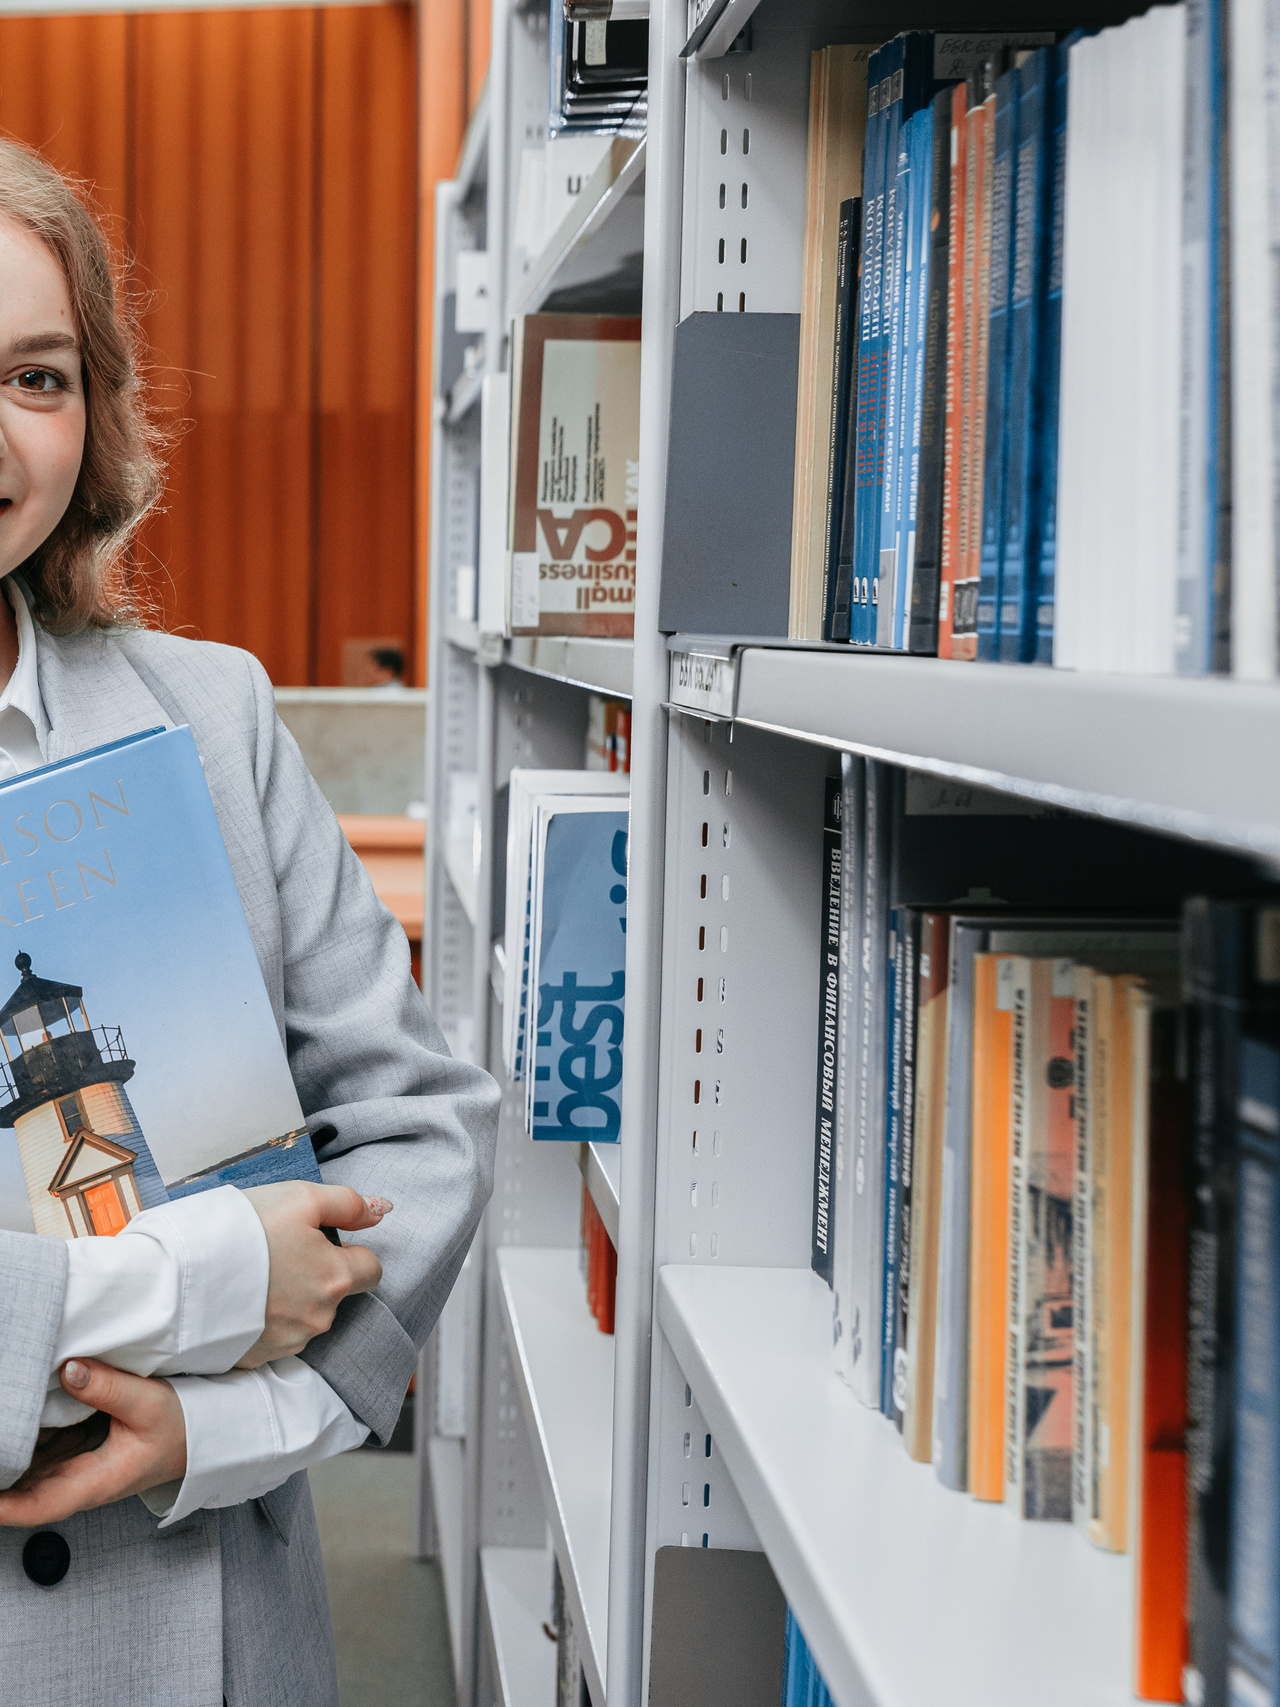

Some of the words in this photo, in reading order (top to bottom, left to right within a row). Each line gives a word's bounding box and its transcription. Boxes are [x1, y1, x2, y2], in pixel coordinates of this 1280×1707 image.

[862, 199, 875, 341] ПЕРСОНАЛОМ
[871, 193, 884, 338] ПЕРСОНАЛОМ
[883, 188, 896, 335] ПЕРСОНАЛОМ
[893, 211, 903, 304] УПРАВЛЕНИЕ
[888, 307, 899, 427] ЧЕЛОВЕЧЕСКИМИ
[884, 431, 894, 513] РЕСУРСАМИ
[539, 563, 637, 586] usiness
[576, 587, 636, 610] mall
[828, 847, 842, 947] ВВЕДЕНИЕ
[827, 954, 838, 966] В
[556, 971, 625, 1142] best
[821, 971, 837, 1115] ФИНАНСОВЫЙ
[816, 1117, 833, 1254] МЕНЕДЖМЕНТ
